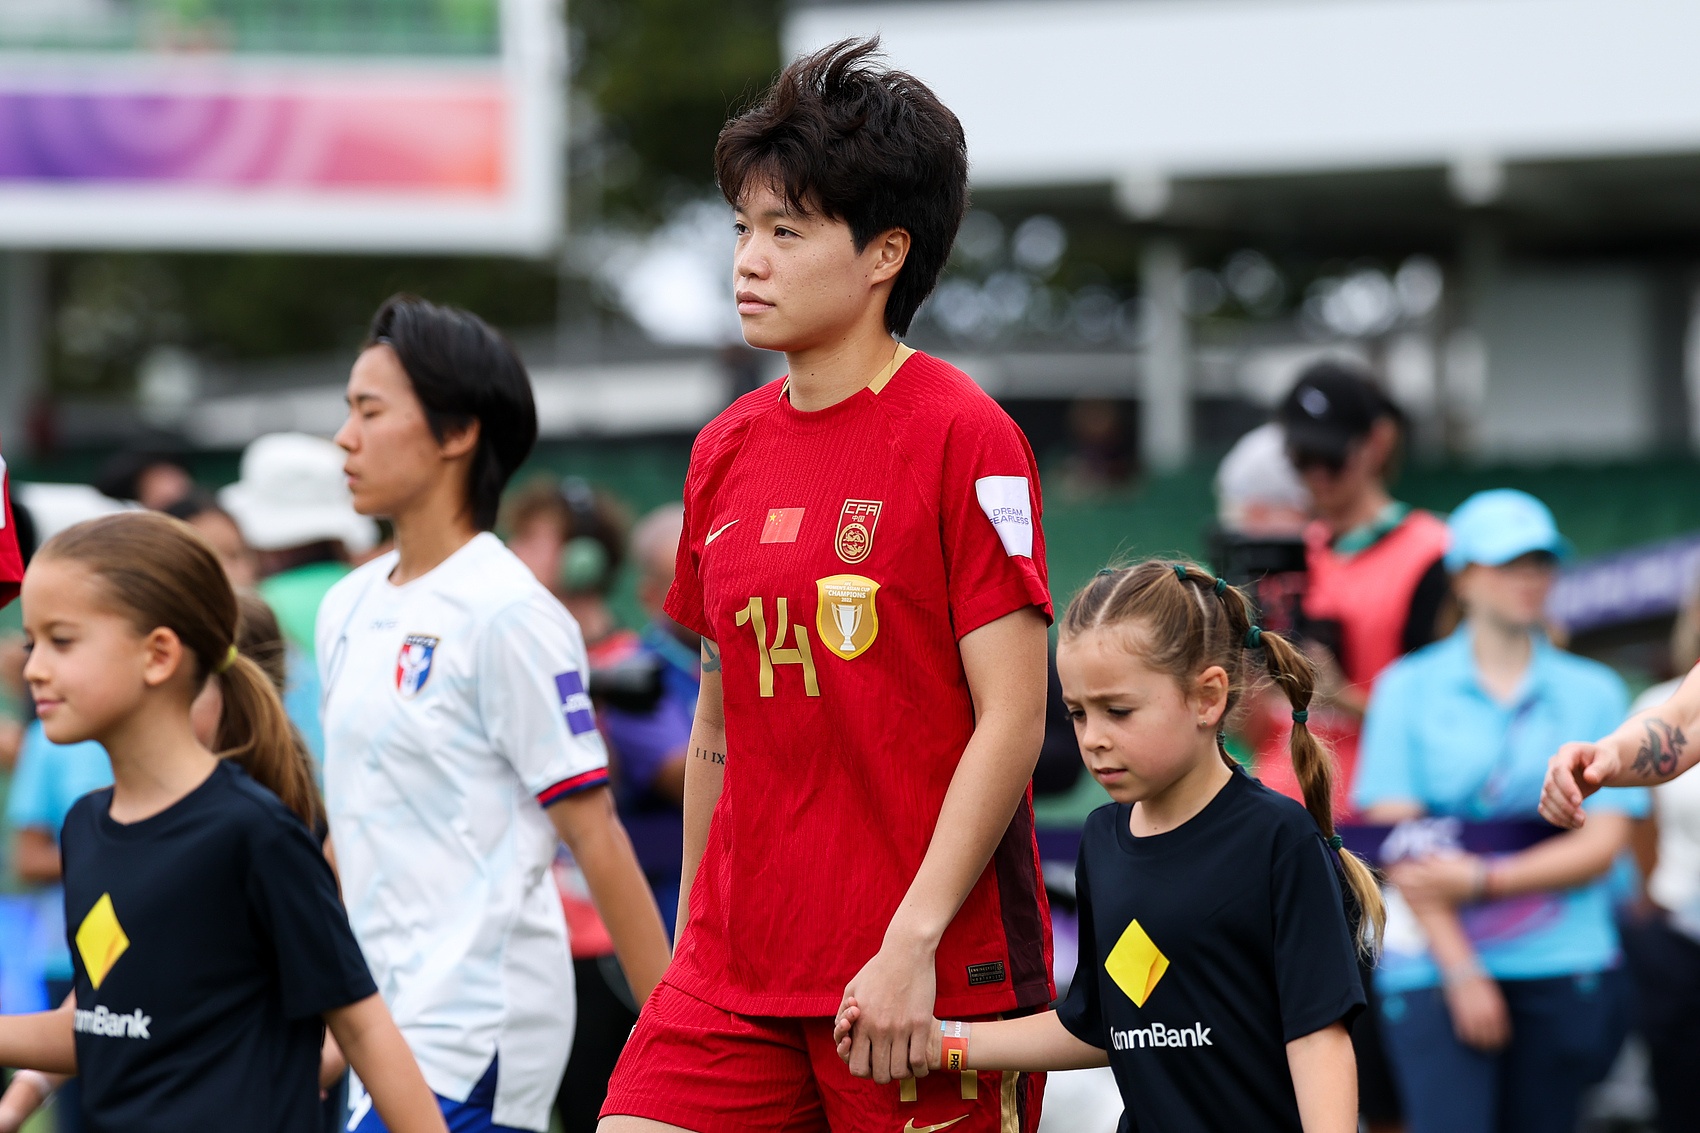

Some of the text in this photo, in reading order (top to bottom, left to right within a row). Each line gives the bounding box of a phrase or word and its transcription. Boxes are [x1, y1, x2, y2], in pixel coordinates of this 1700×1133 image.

[845, 503, 878, 516] CFA
[993, 507, 1023, 516] DREAM
[828, 590, 866, 599] CHAMPIONS
[735, 597, 821, 697] 14
